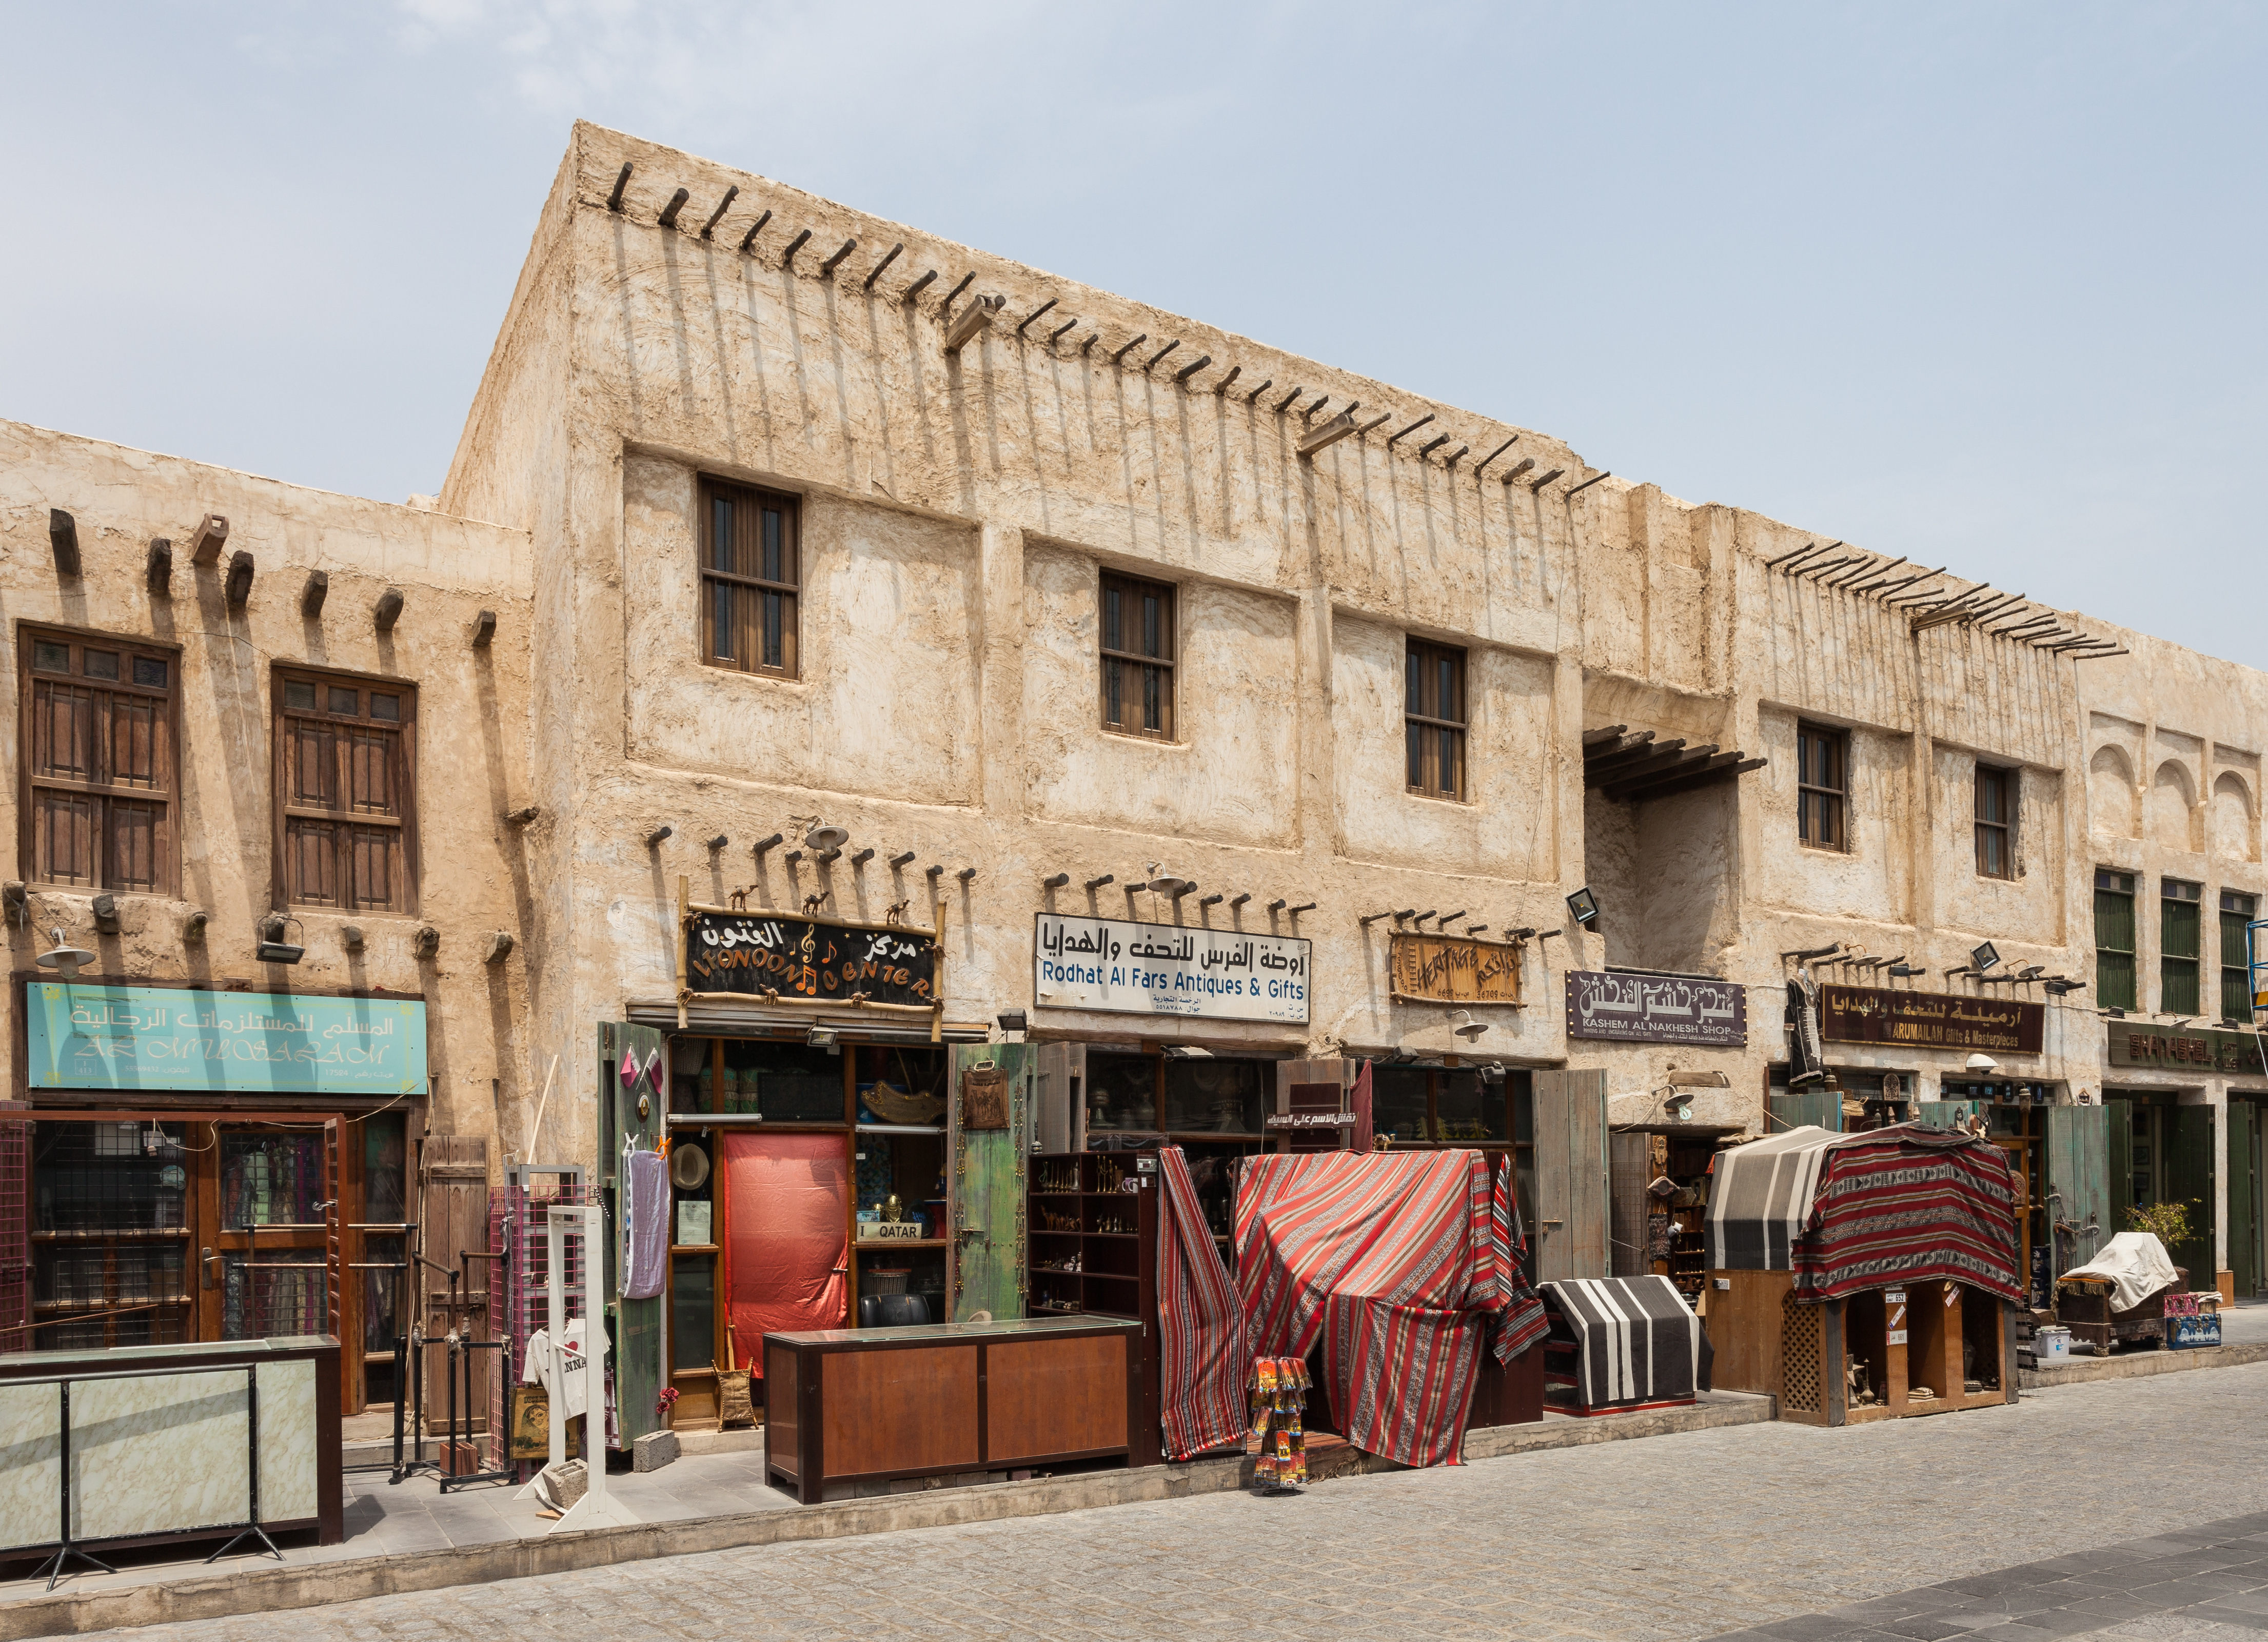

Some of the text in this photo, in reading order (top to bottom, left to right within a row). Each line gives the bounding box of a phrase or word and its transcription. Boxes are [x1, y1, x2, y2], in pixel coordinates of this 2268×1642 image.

[702, 918, 916, 961] مركز الفنون
[1042, 922, 1304, 976] روضة الفرس للتحف والهدايا
[823, 961, 929, 997] CENTER
[1042, 961, 1304, 1000] Rodhat Al Fars Antiques & Gifts
[1153, 994, 1177, 1003] التجارية
[1831, 994, 1888, 1019] والهدايا
[1893, 999, 1946, 1019] للتحف
[177, 1011, 313, 1033] للمستلزمات
[1583, 1018, 1628, 1029] KASHEM
[1632, 1021, 1647, 1030] AL
[1649, 1022, 1699, 1033] NAKHESH
[1702, 1025, 1731, 1035] SHOP
[1892, 1022, 1943, 1042] ARUMAILAH
[1946, 1029, 1963, 1044] Gifts
[1964, 1030, 1970, 1043] &
[1973, 1030, 2019, 1049] Masterpieces
[1268, 1114, 1293, 1126] السيف
[1293, 1114, 1310, 1126] على
[860, 1225, 917, 1238] I QATAR
